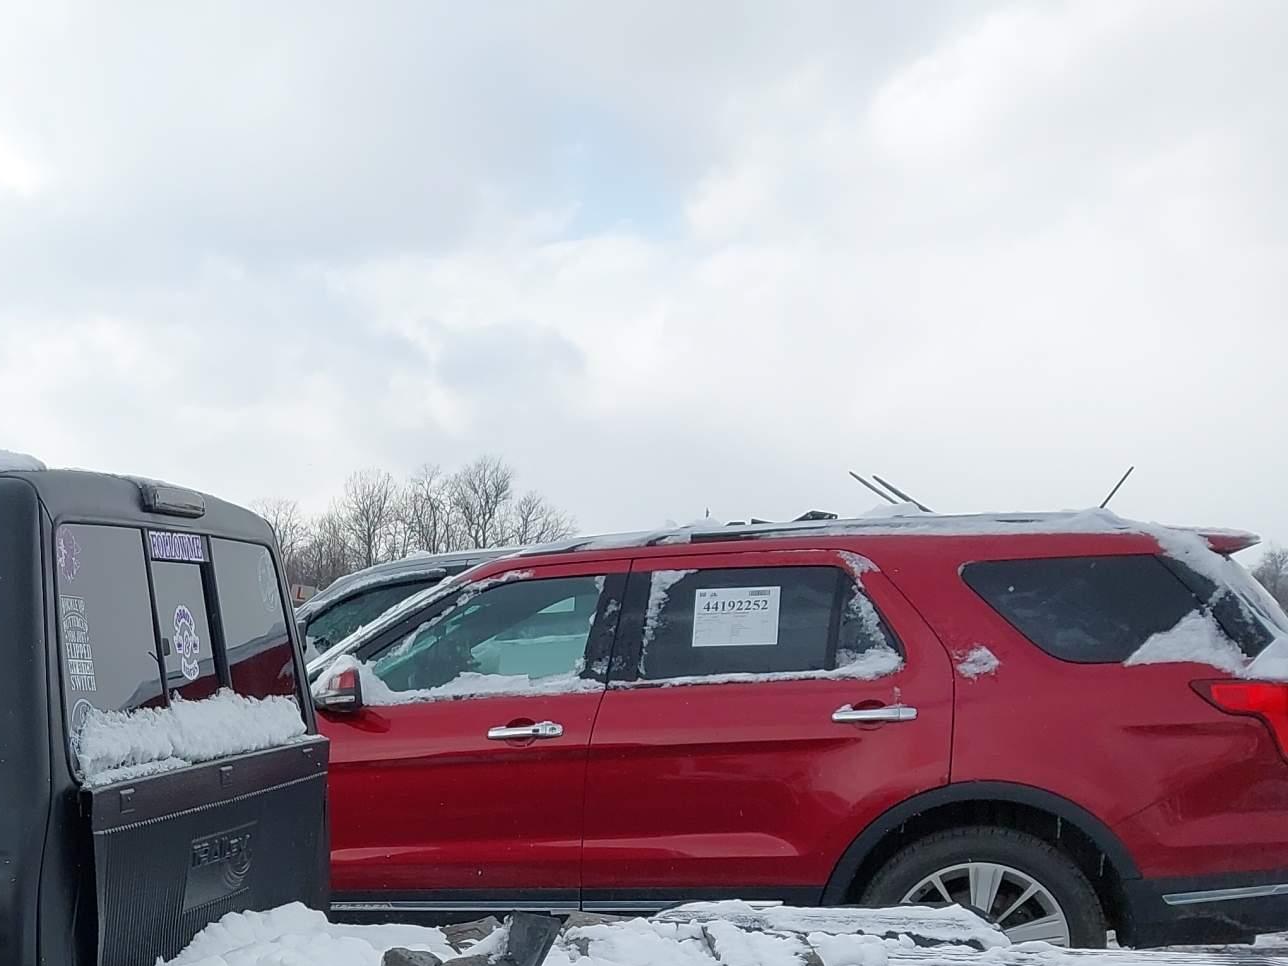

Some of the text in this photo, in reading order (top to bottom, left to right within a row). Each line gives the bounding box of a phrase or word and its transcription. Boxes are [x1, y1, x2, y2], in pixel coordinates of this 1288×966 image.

[296, 586, 306, 600] L
[703, 600, 769, 612] 44192252
[66, 643, 92, 659] FLIPPED
[71, 675, 96, 691] SWITCH
